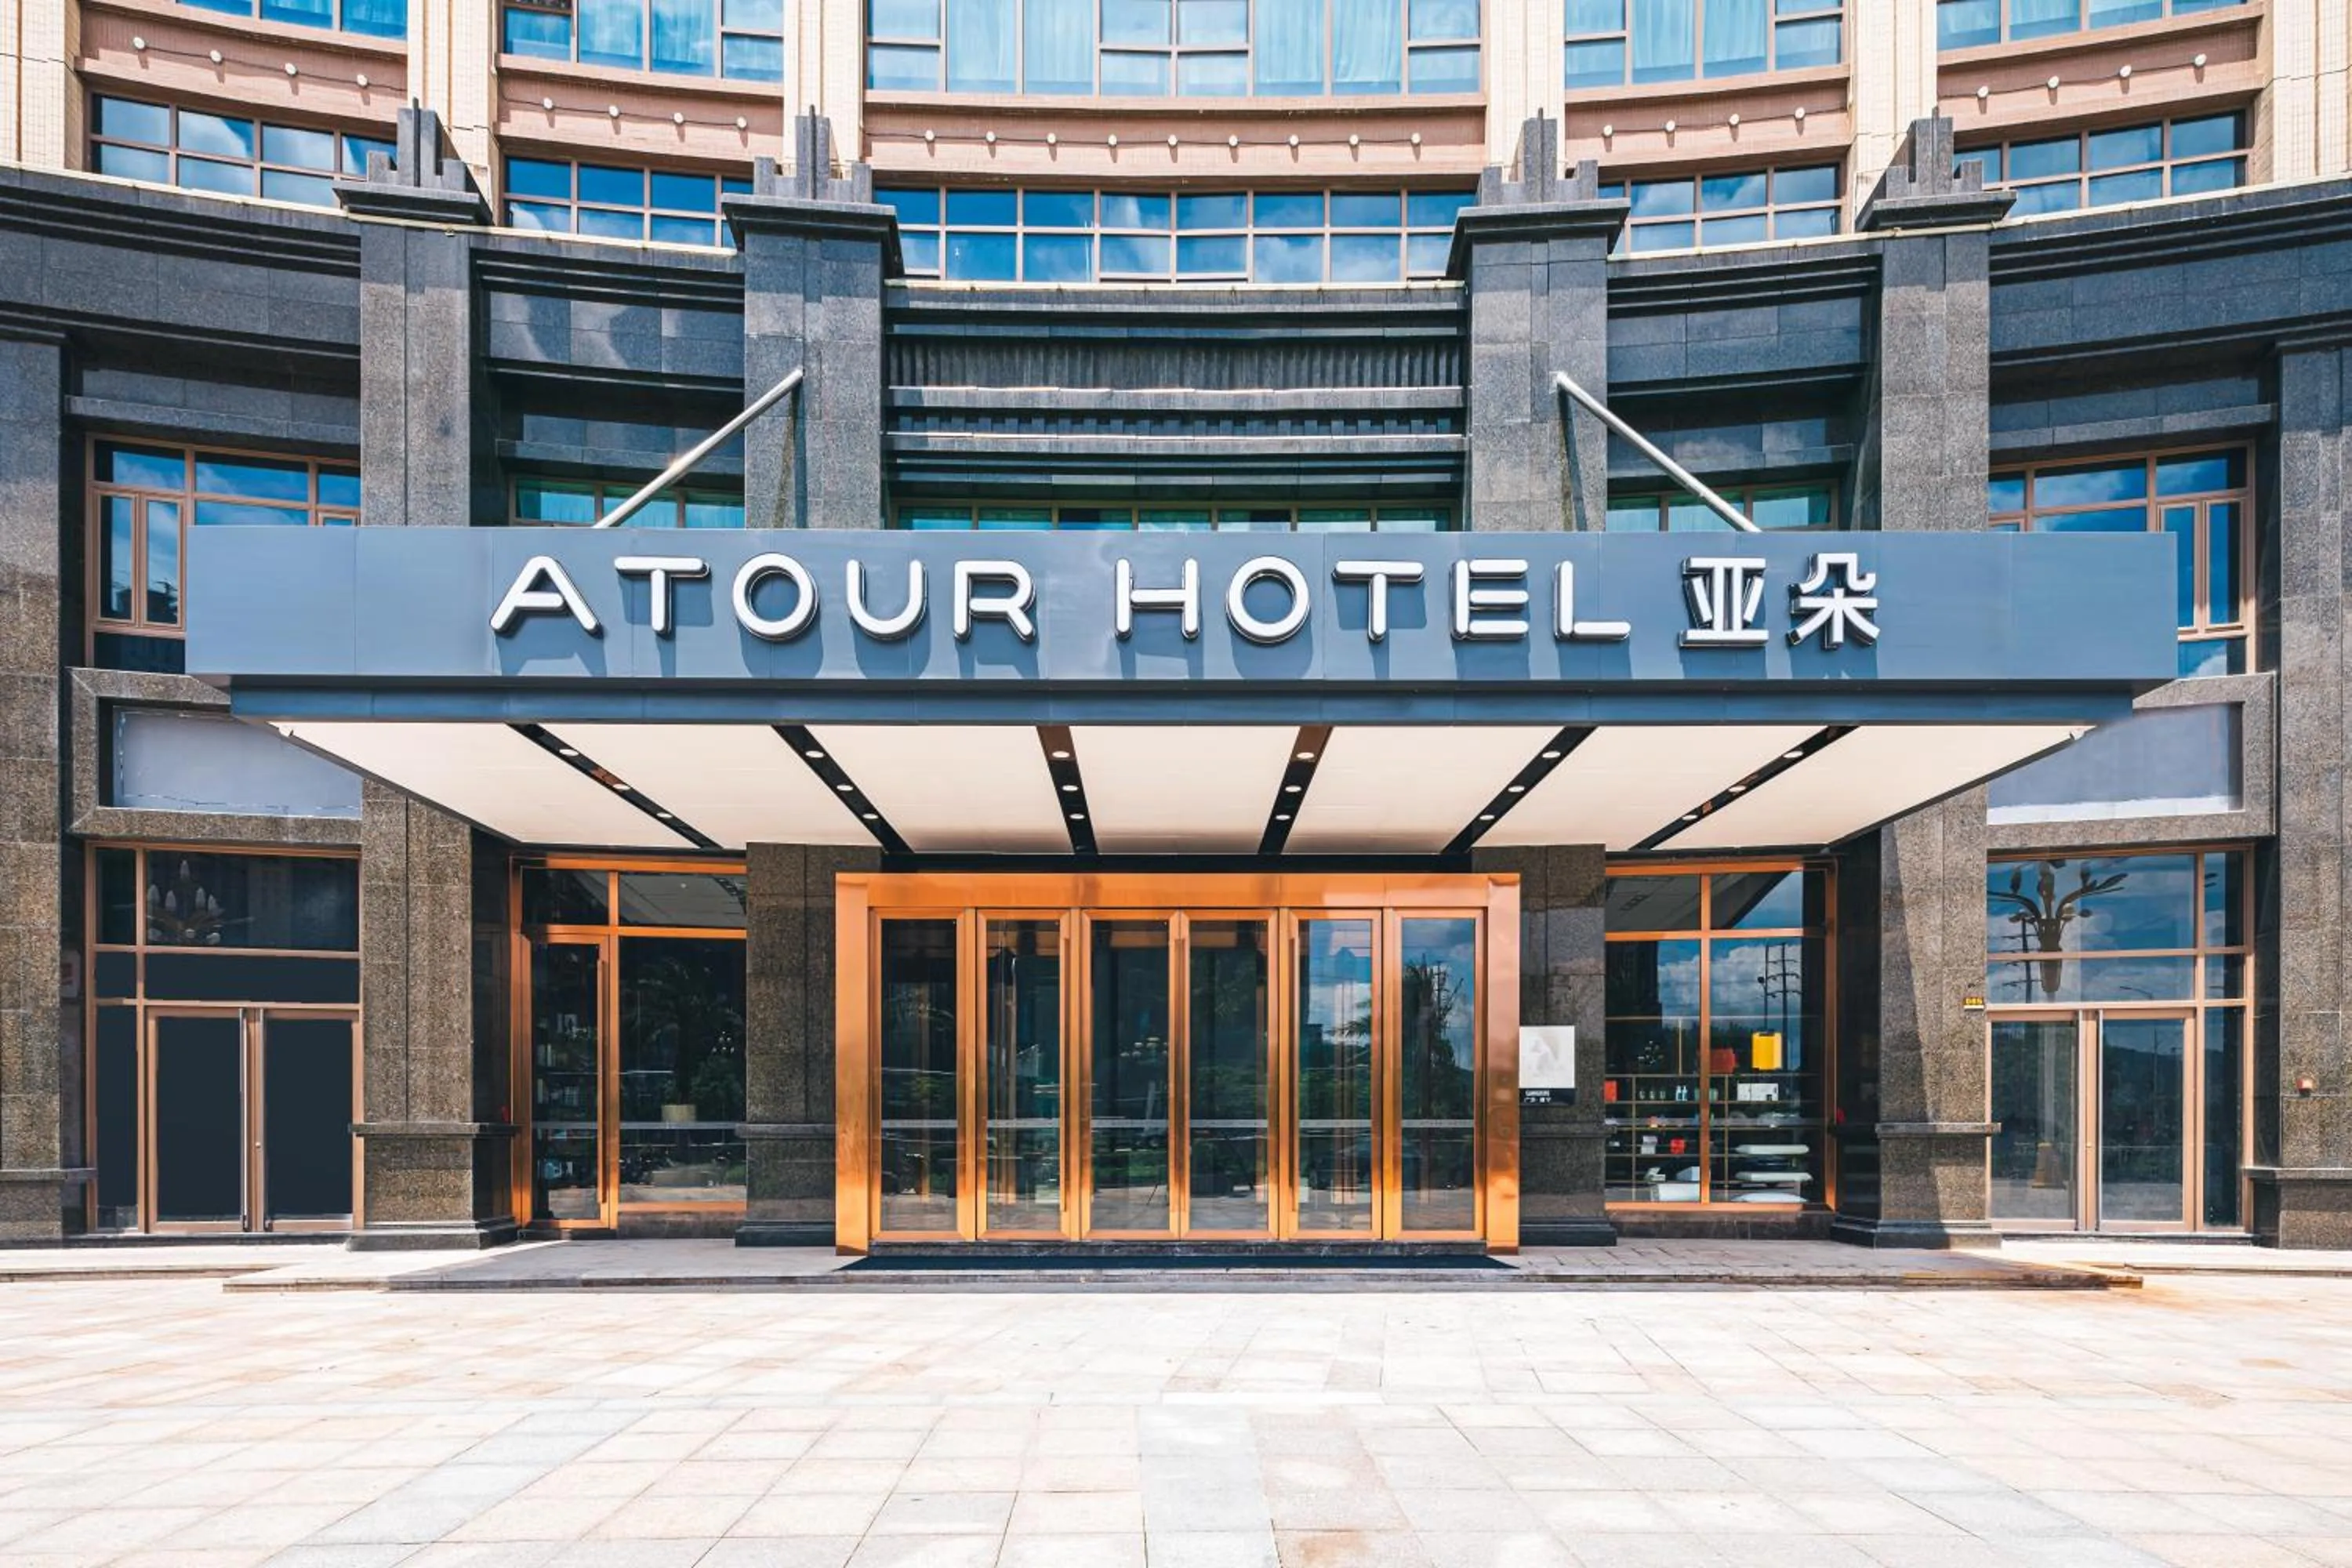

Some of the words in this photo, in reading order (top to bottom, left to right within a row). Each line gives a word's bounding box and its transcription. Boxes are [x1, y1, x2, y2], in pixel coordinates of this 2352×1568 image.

[489, 552, 1036, 641] ATOUR
[1114, 555, 1632, 644] HOTEL
[1679, 552, 1881, 648] 亚朵
